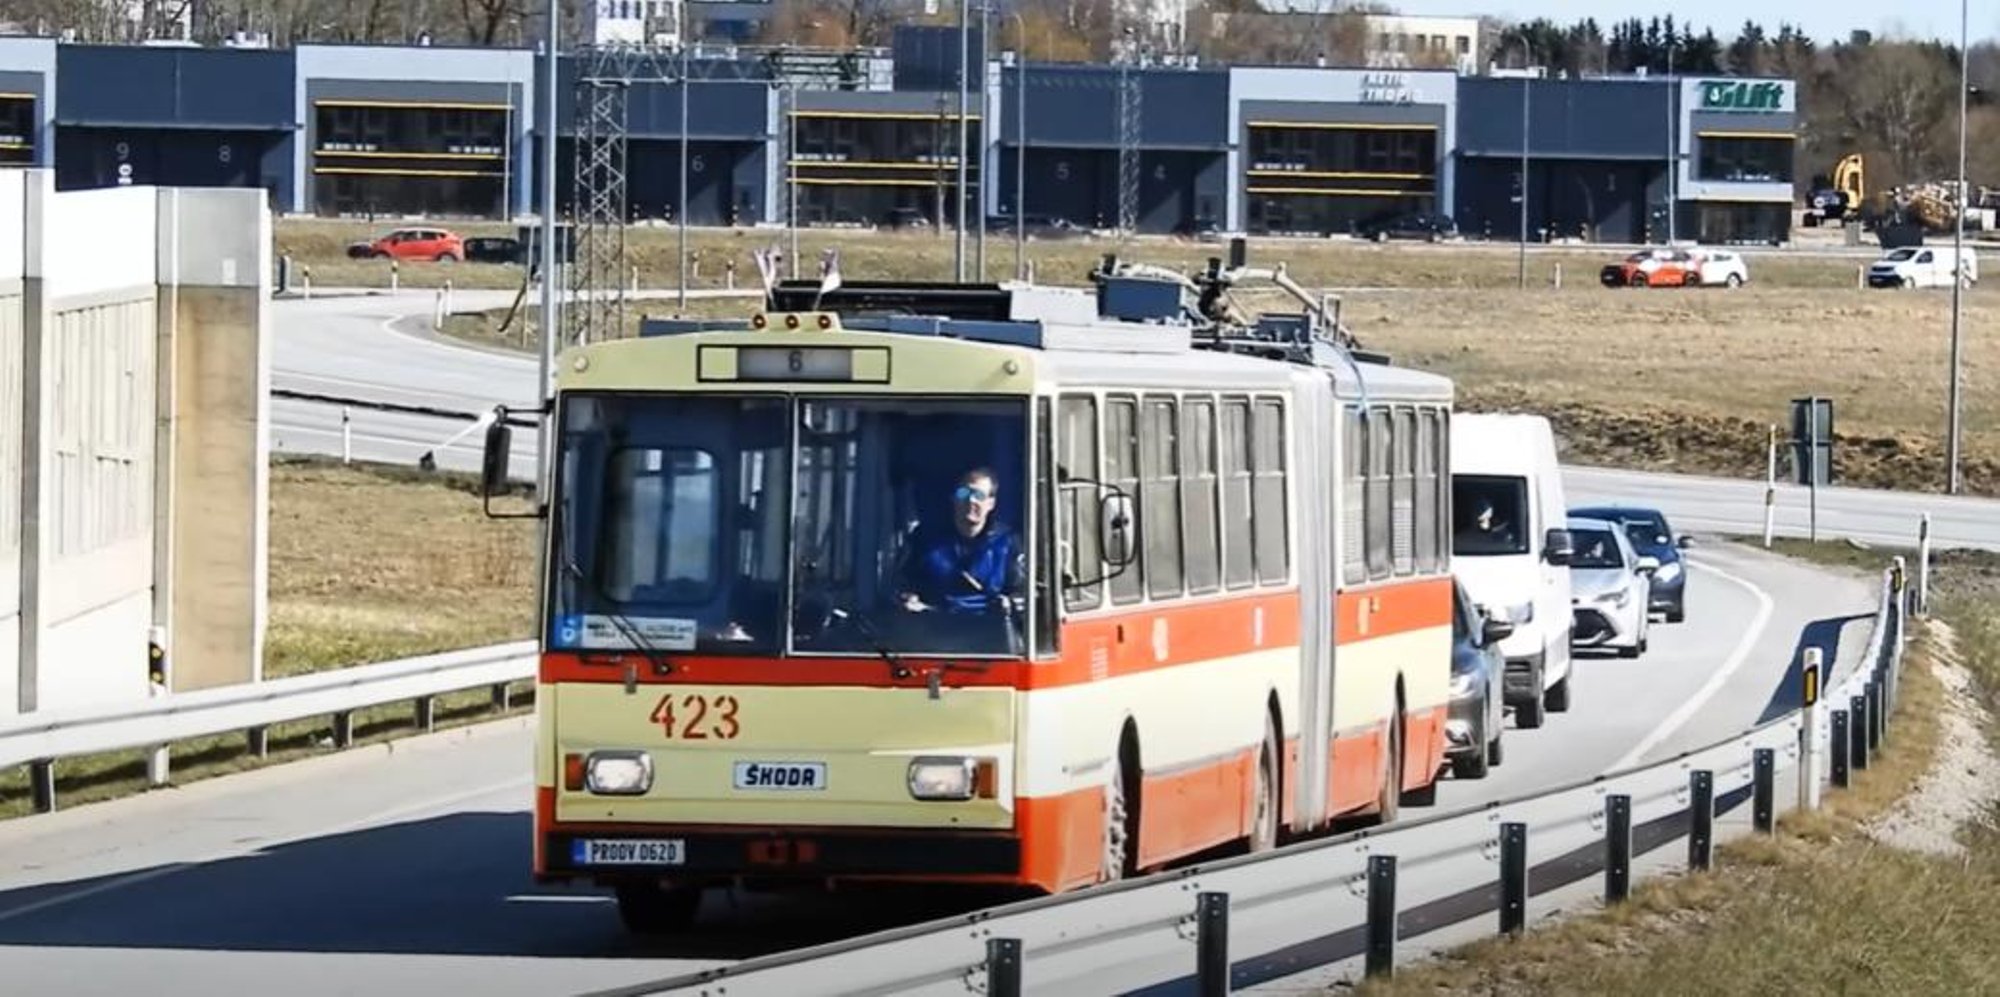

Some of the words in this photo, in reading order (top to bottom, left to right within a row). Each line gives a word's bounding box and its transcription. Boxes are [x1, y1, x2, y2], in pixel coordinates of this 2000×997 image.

[116, 142, 130, 160] 9
[219, 145, 231, 162] 8
[692, 155, 704, 171] 6
[788, 351, 804, 372] 6
[649, 694, 740, 739] 423
[744, 764, 816, 786] ŠKODA
